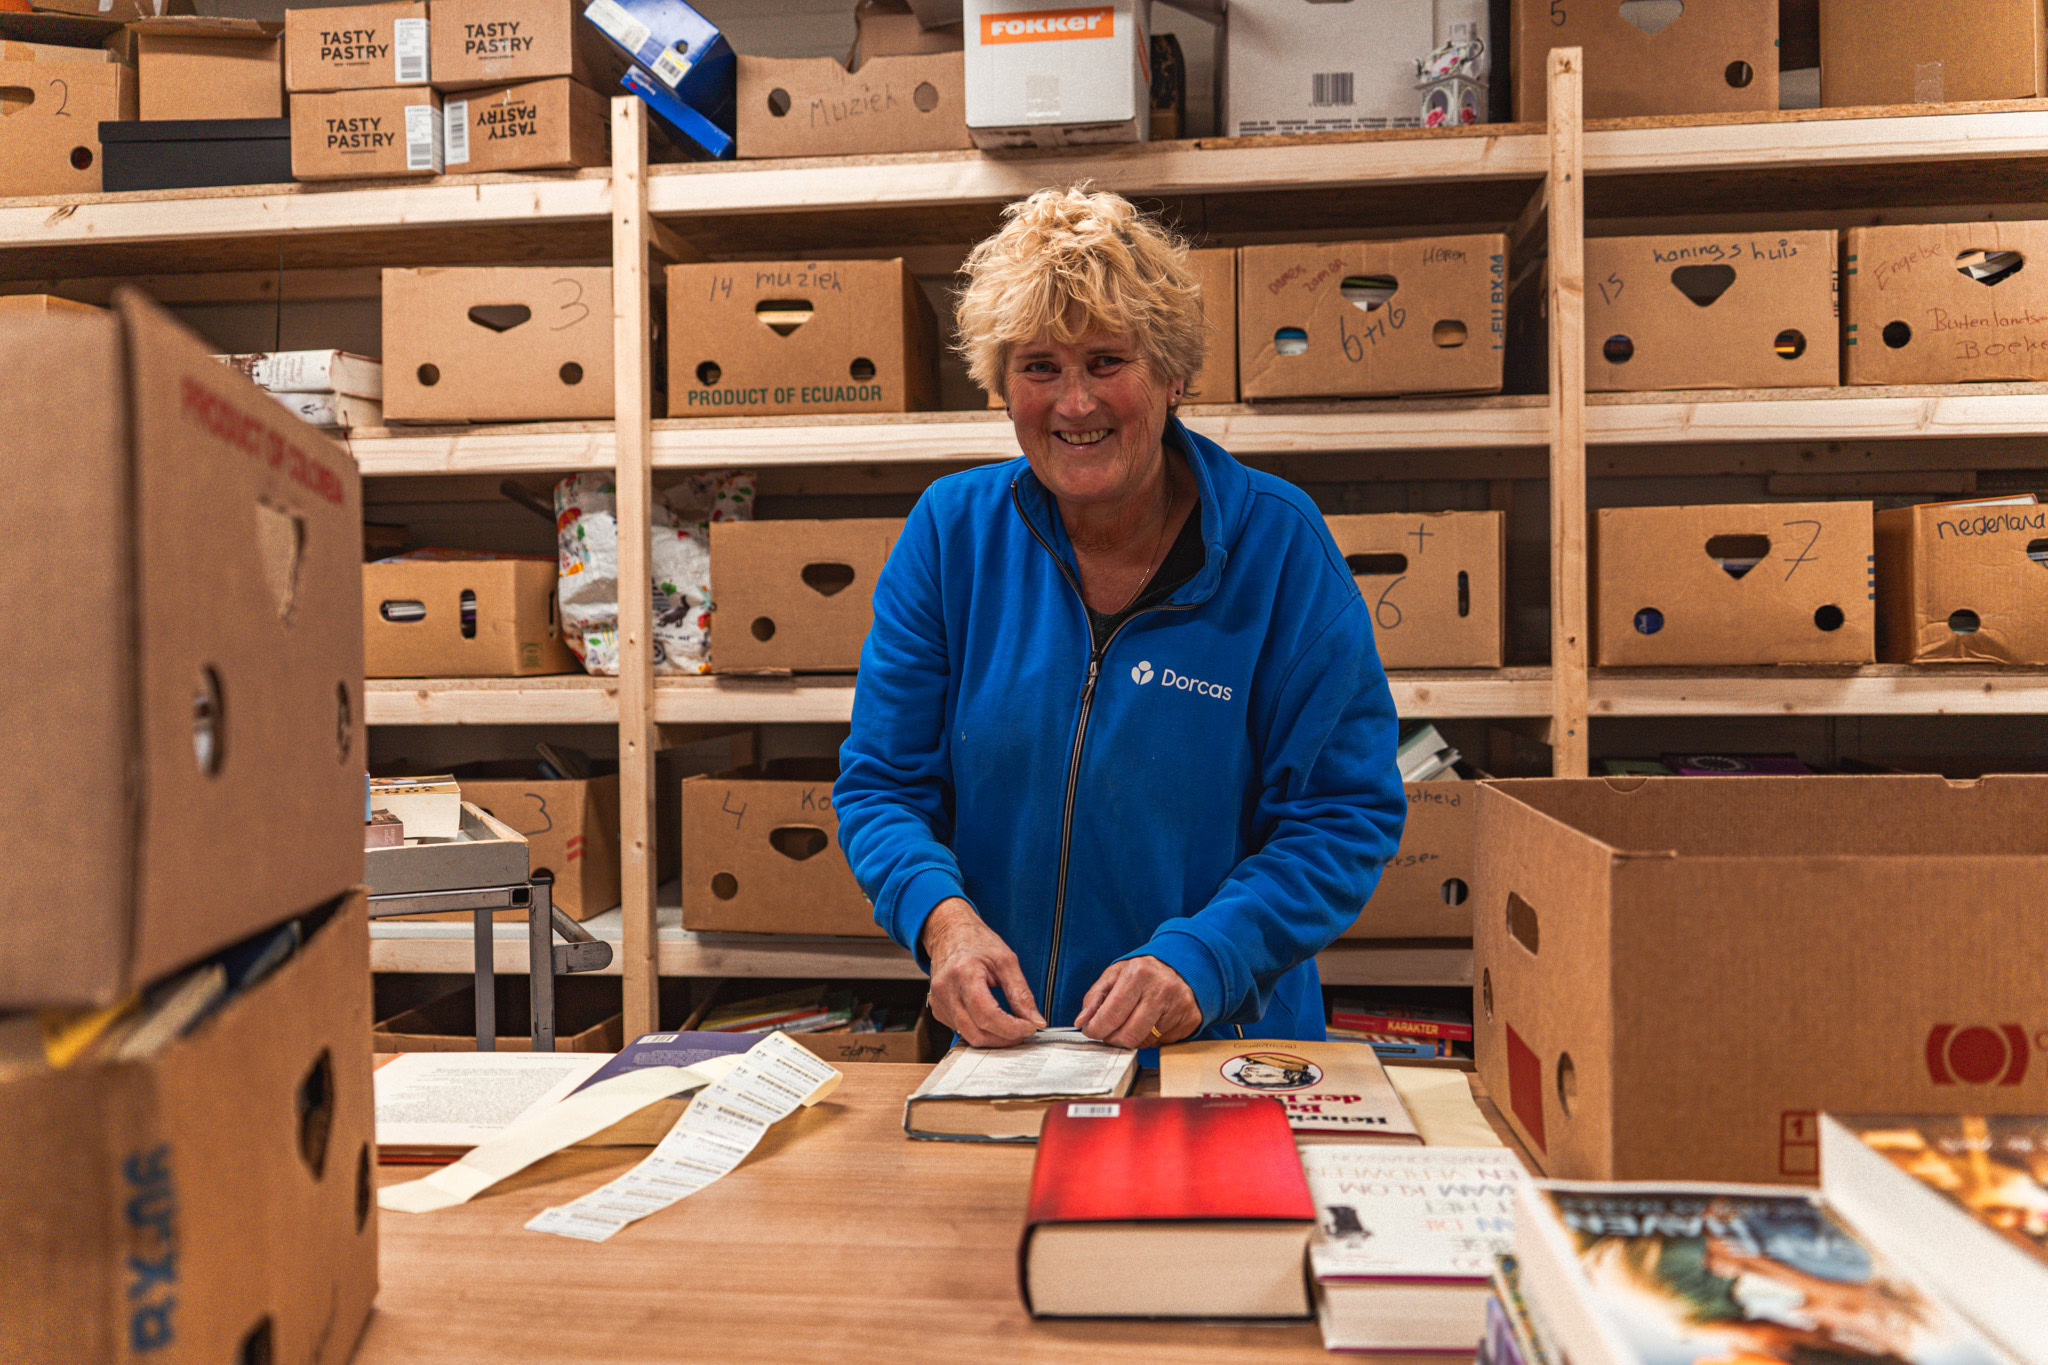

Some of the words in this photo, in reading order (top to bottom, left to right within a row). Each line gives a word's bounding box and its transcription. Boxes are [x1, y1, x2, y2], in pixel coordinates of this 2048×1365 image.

[1550, 0, 1567, 27] 5
[320, 30, 376, 45] TASTY
[464, 22, 520, 38] TASTY
[320, 44, 389, 60] PASTRY
[465, 37, 533, 54] PASTRY
[50, 78, 71, 117] 2
[326, 117, 381, 133] TASTY
[476, 105, 537, 127] PASTRY
[327, 132, 395, 149] PASTRY
[488, 121, 537, 140] TASTY
[709, 275, 733, 303] 14
[549, 277, 590, 332] 3
[688, 388, 768, 406] PRODUCT
[774, 387, 795, 404] OF
[801, 385, 882, 403] ECUADOR
[1783, 519, 1822, 582] 7
[1375, 576, 1407, 629] 6
[1161, 668, 1233, 701] Dorcas
[523, 793, 553, 837] 3
[722, 791, 748, 830] 4
[1387, 1020, 1440, 1036] KARAKTER
